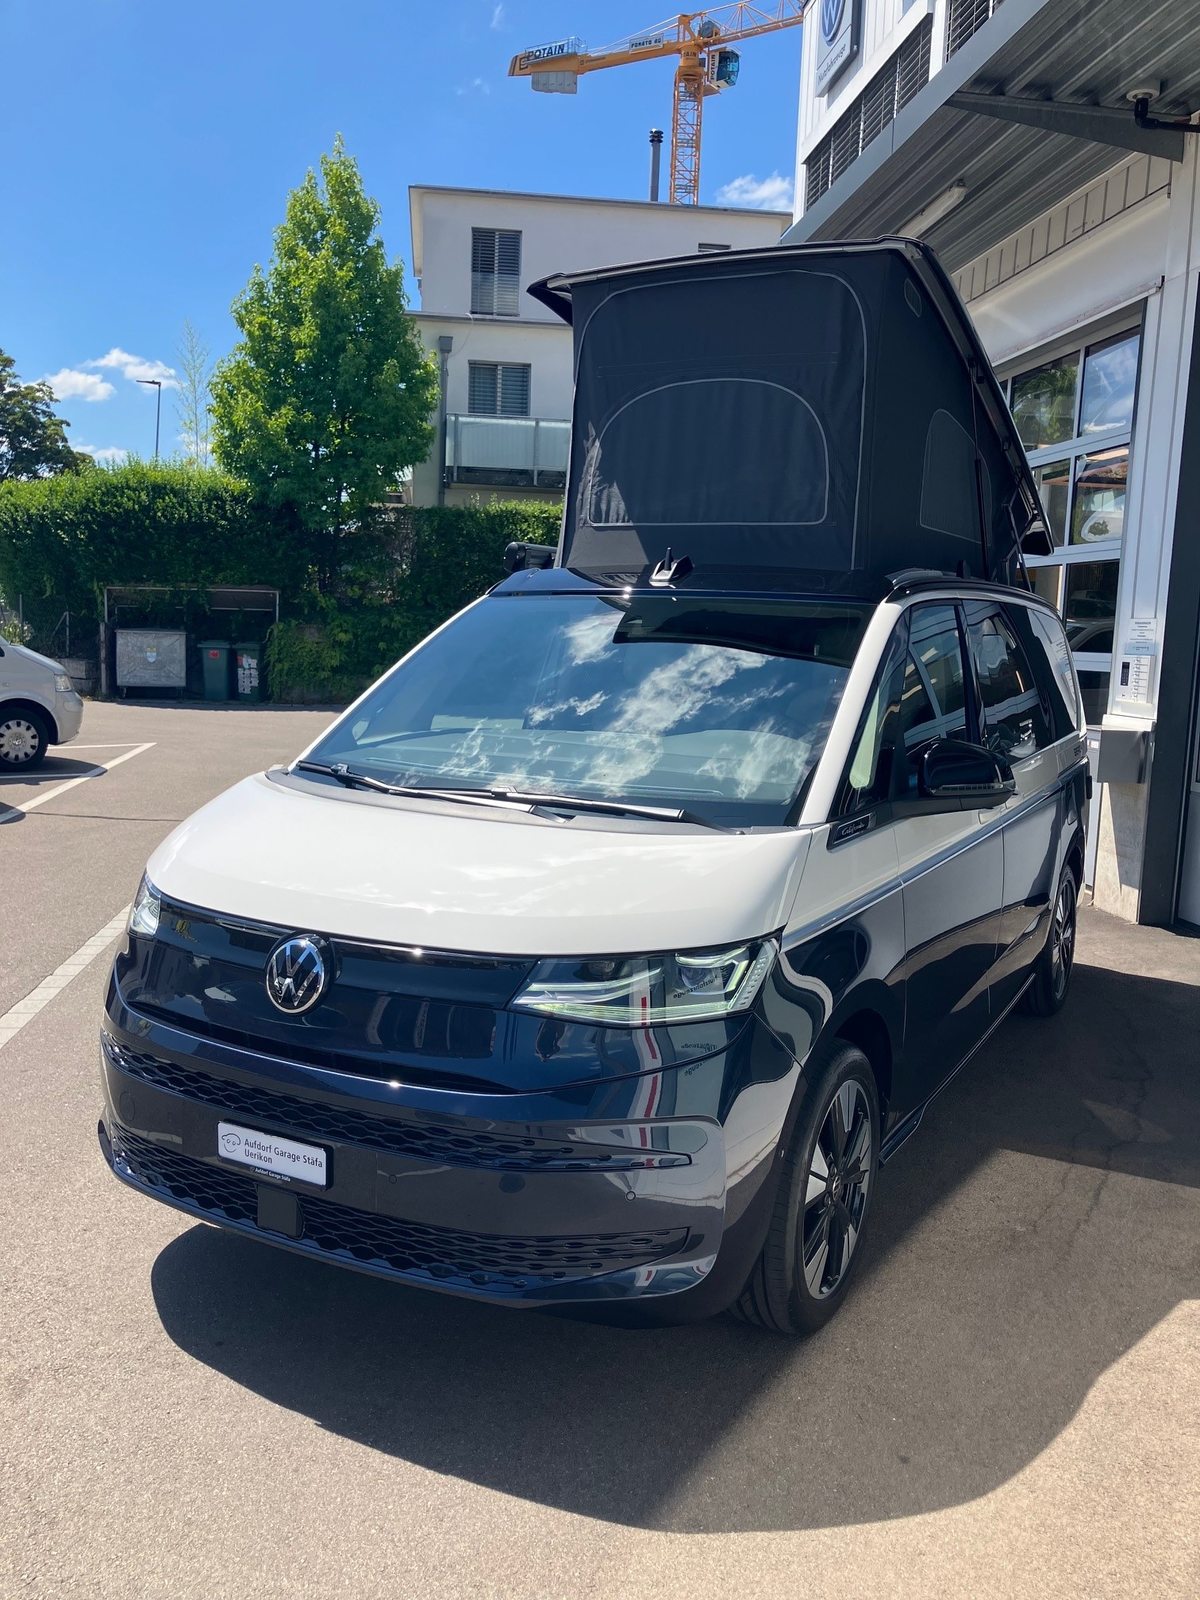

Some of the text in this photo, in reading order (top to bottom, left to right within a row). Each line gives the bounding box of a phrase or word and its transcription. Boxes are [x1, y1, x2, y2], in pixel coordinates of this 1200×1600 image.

[526, 44, 565, 62] POTAIN
[244, 1138, 323, 1168] Aufdorf Garage Stäfa
[244, 1148, 273, 1164] Uerikon
